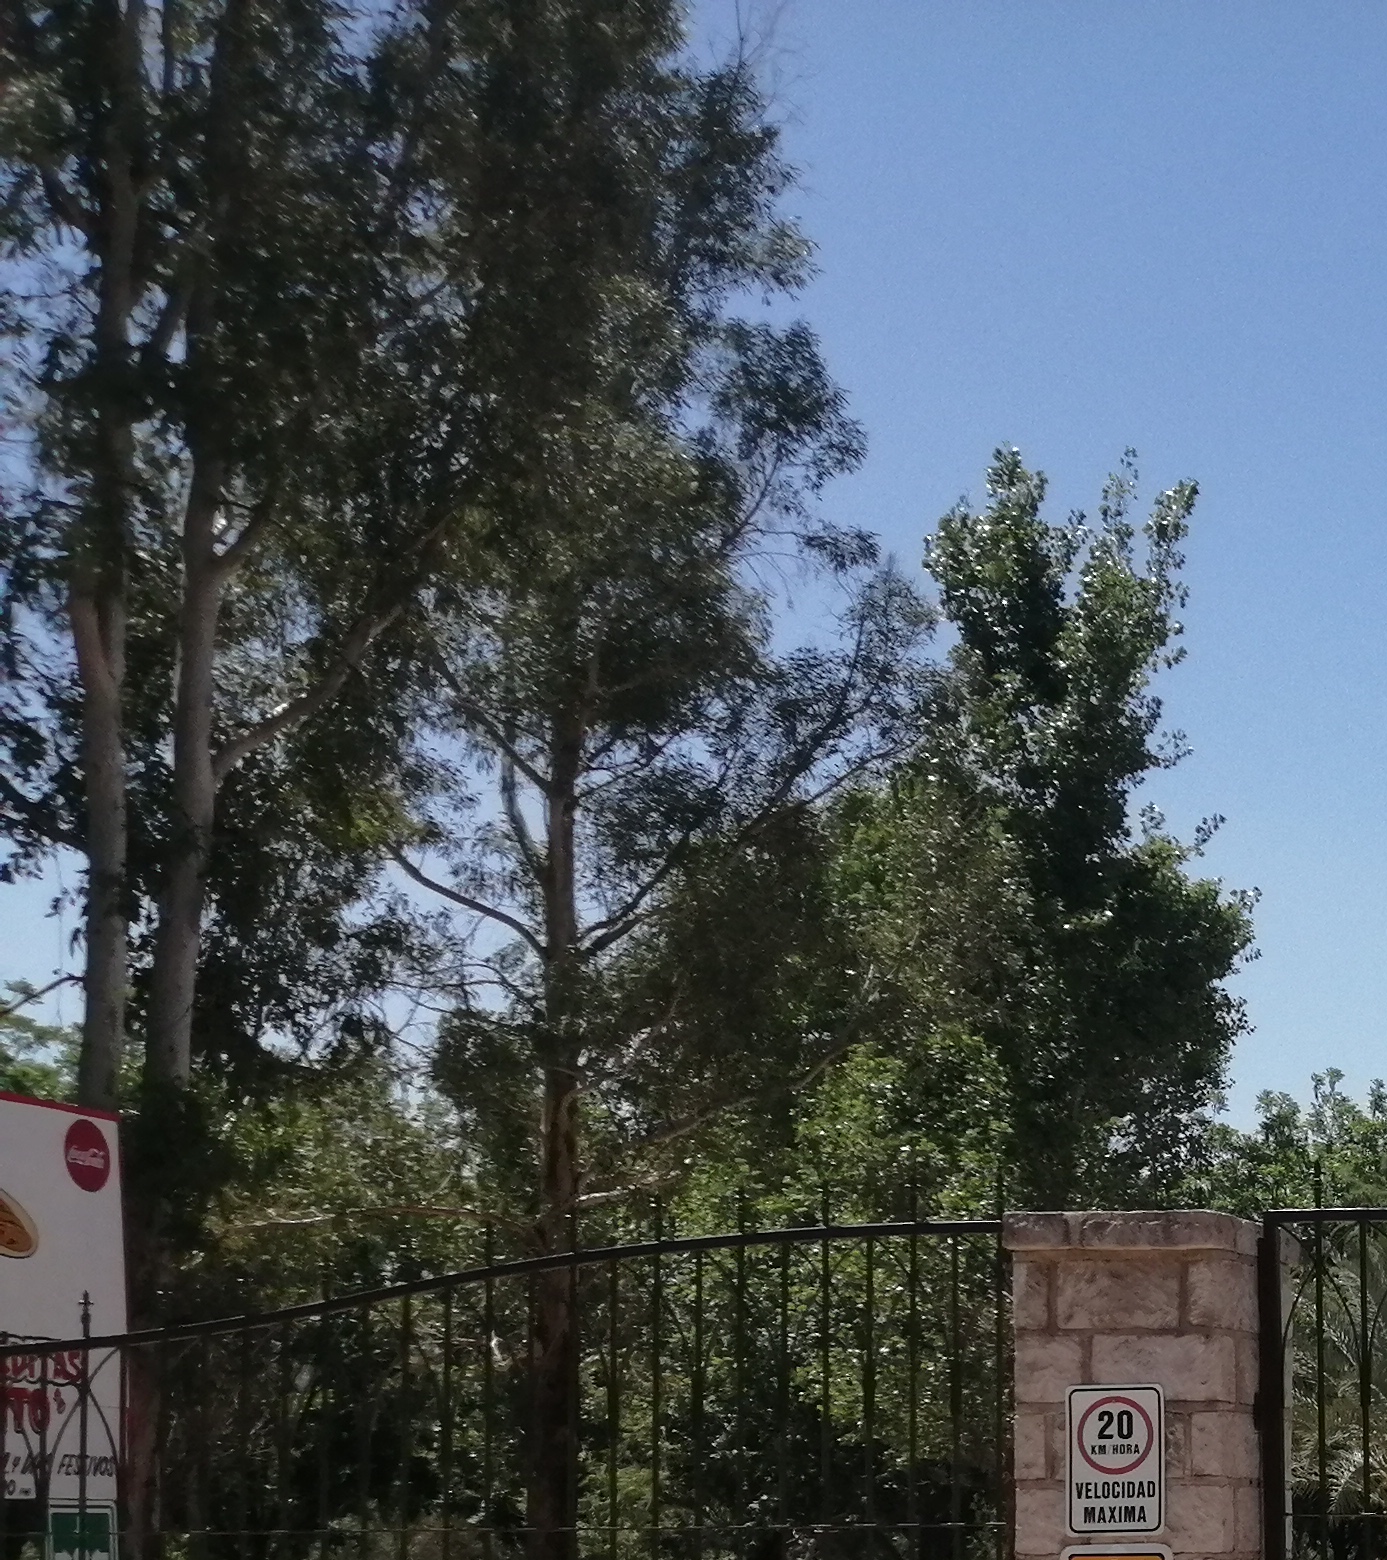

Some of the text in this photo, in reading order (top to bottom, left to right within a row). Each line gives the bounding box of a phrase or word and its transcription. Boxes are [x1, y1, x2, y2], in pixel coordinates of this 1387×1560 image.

[1098, 1410, 1134, 1440] 20
[1075, 1480, 1156, 1500] VELOCIDAD
[1083, 1505, 1147, 1524] MAXIMA
